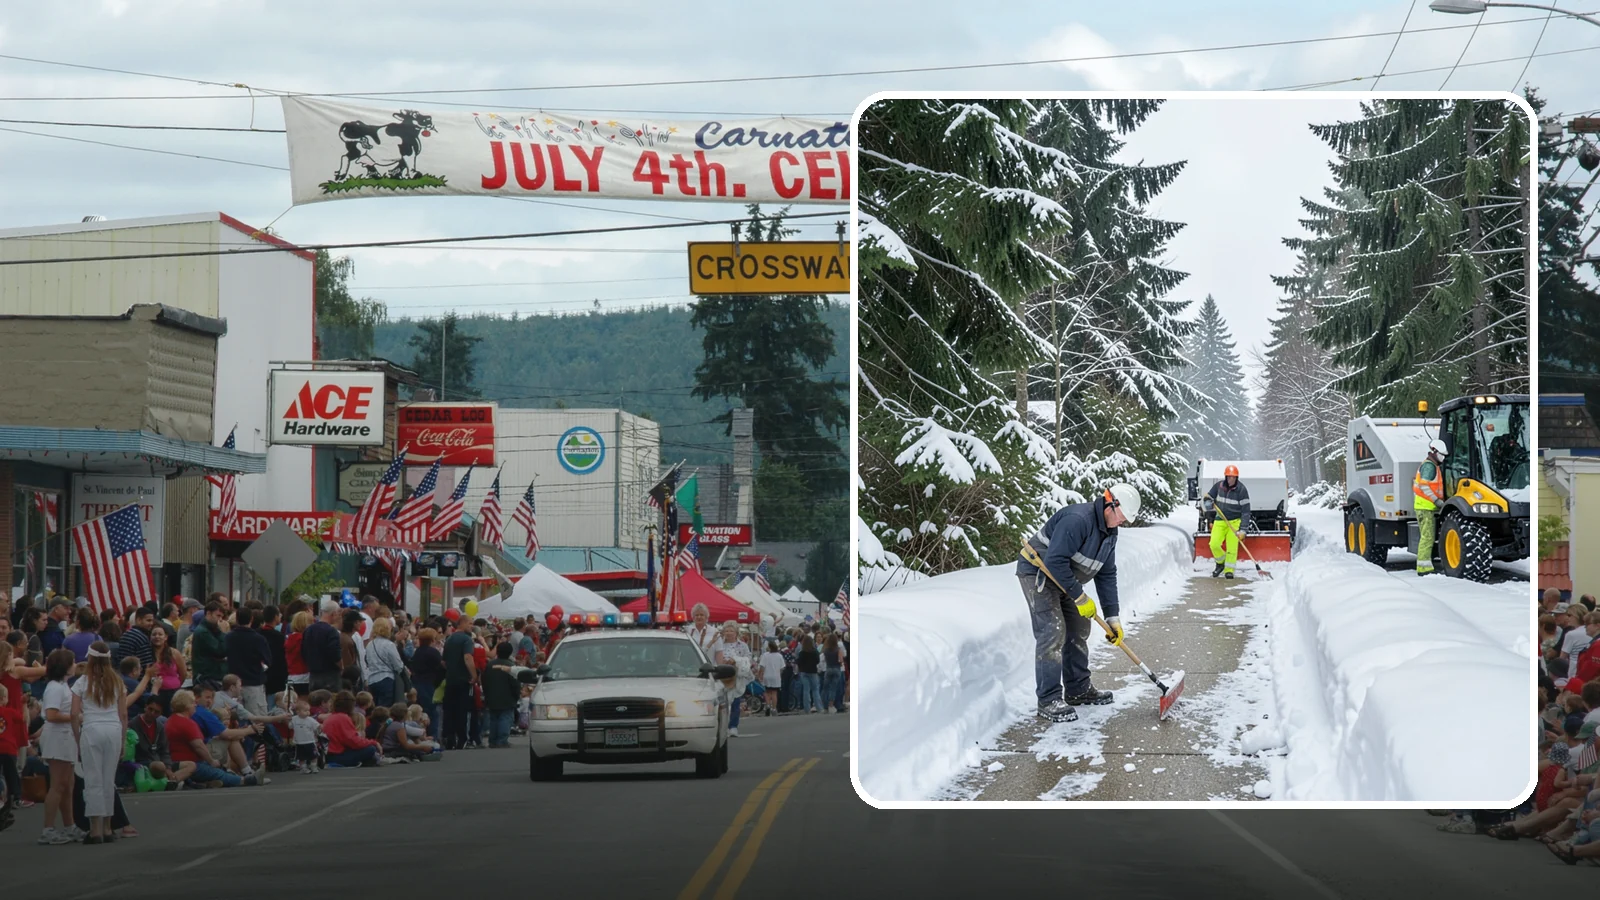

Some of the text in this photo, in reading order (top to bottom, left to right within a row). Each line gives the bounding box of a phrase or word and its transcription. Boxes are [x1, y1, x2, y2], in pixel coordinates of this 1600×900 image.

[481, 141, 604, 192] JULY
[632, 150, 746, 197] 4th.
[697, 254, 850, 280] CROSSWA
[283, 380, 373, 420] ACE
[406, 409, 452, 421] CEDAR
[283, 421, 370, 436] Hardware
[416, 428, 477, 447] Coca-Cola
[95, 485, 124, 495] Vincent
[126, 486, 136, 494] de
[138, 486, 155, 495] Paul
[688, 526, 741, 535] CRNATION
[699, 535, 730, 543] GLASS
